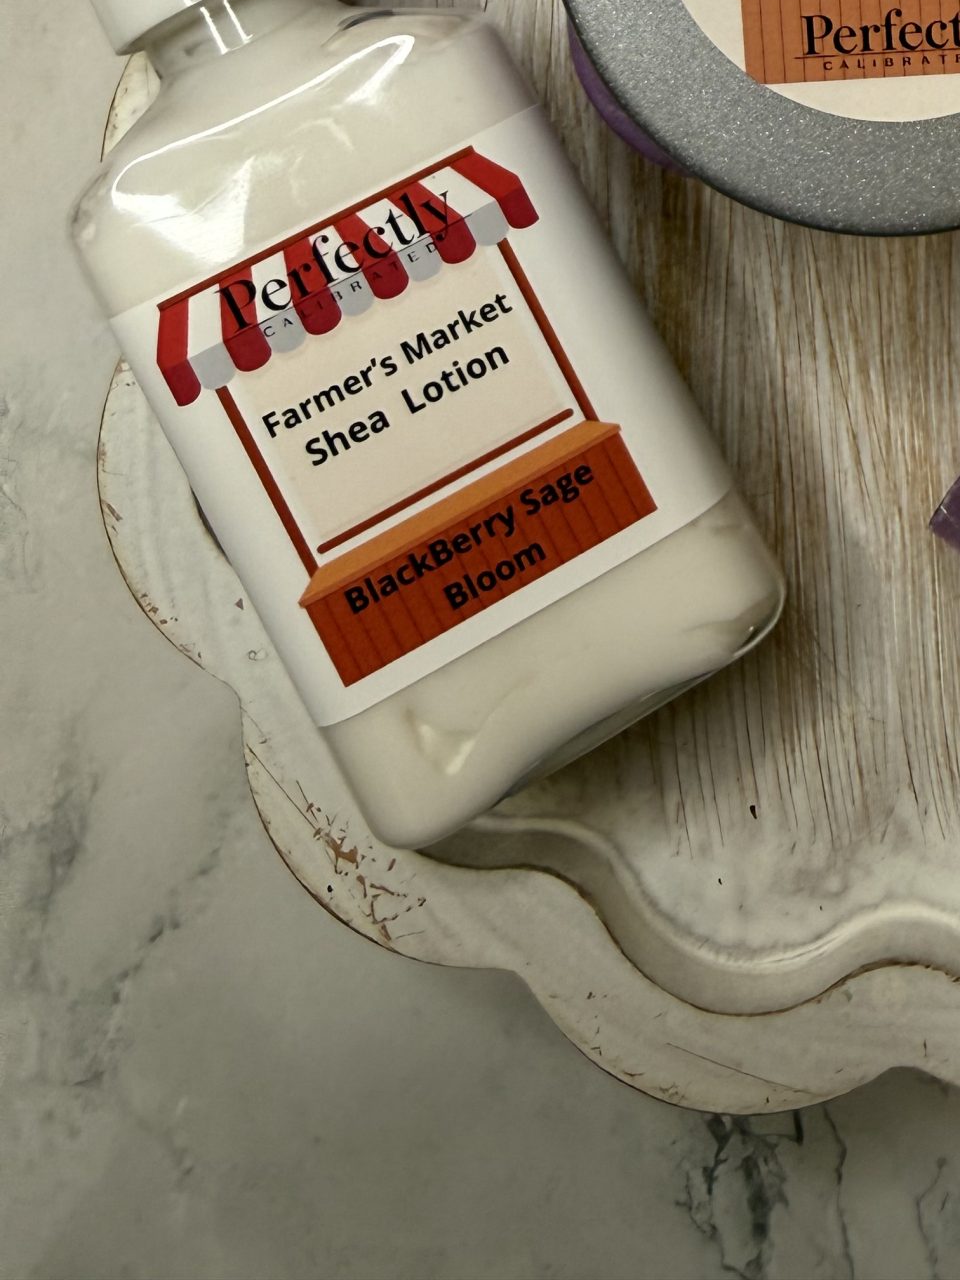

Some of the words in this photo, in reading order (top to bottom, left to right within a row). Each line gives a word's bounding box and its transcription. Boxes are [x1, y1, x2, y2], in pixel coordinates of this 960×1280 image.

[215, 189, 451, 334] Perfectly
[263, 242, 438, 338] CALIBRATED
[261, 354, 398, 438] Farmer's
[400, 293, 513, 365] Market
[305, 409, 391, 466] Shea
[401, 345, 510, 415] Lotion
[345, 504, 517, 615] BlackBerry
[519, 462, 595, 516] Sage
[443, 538, 547, 609] Bloom
